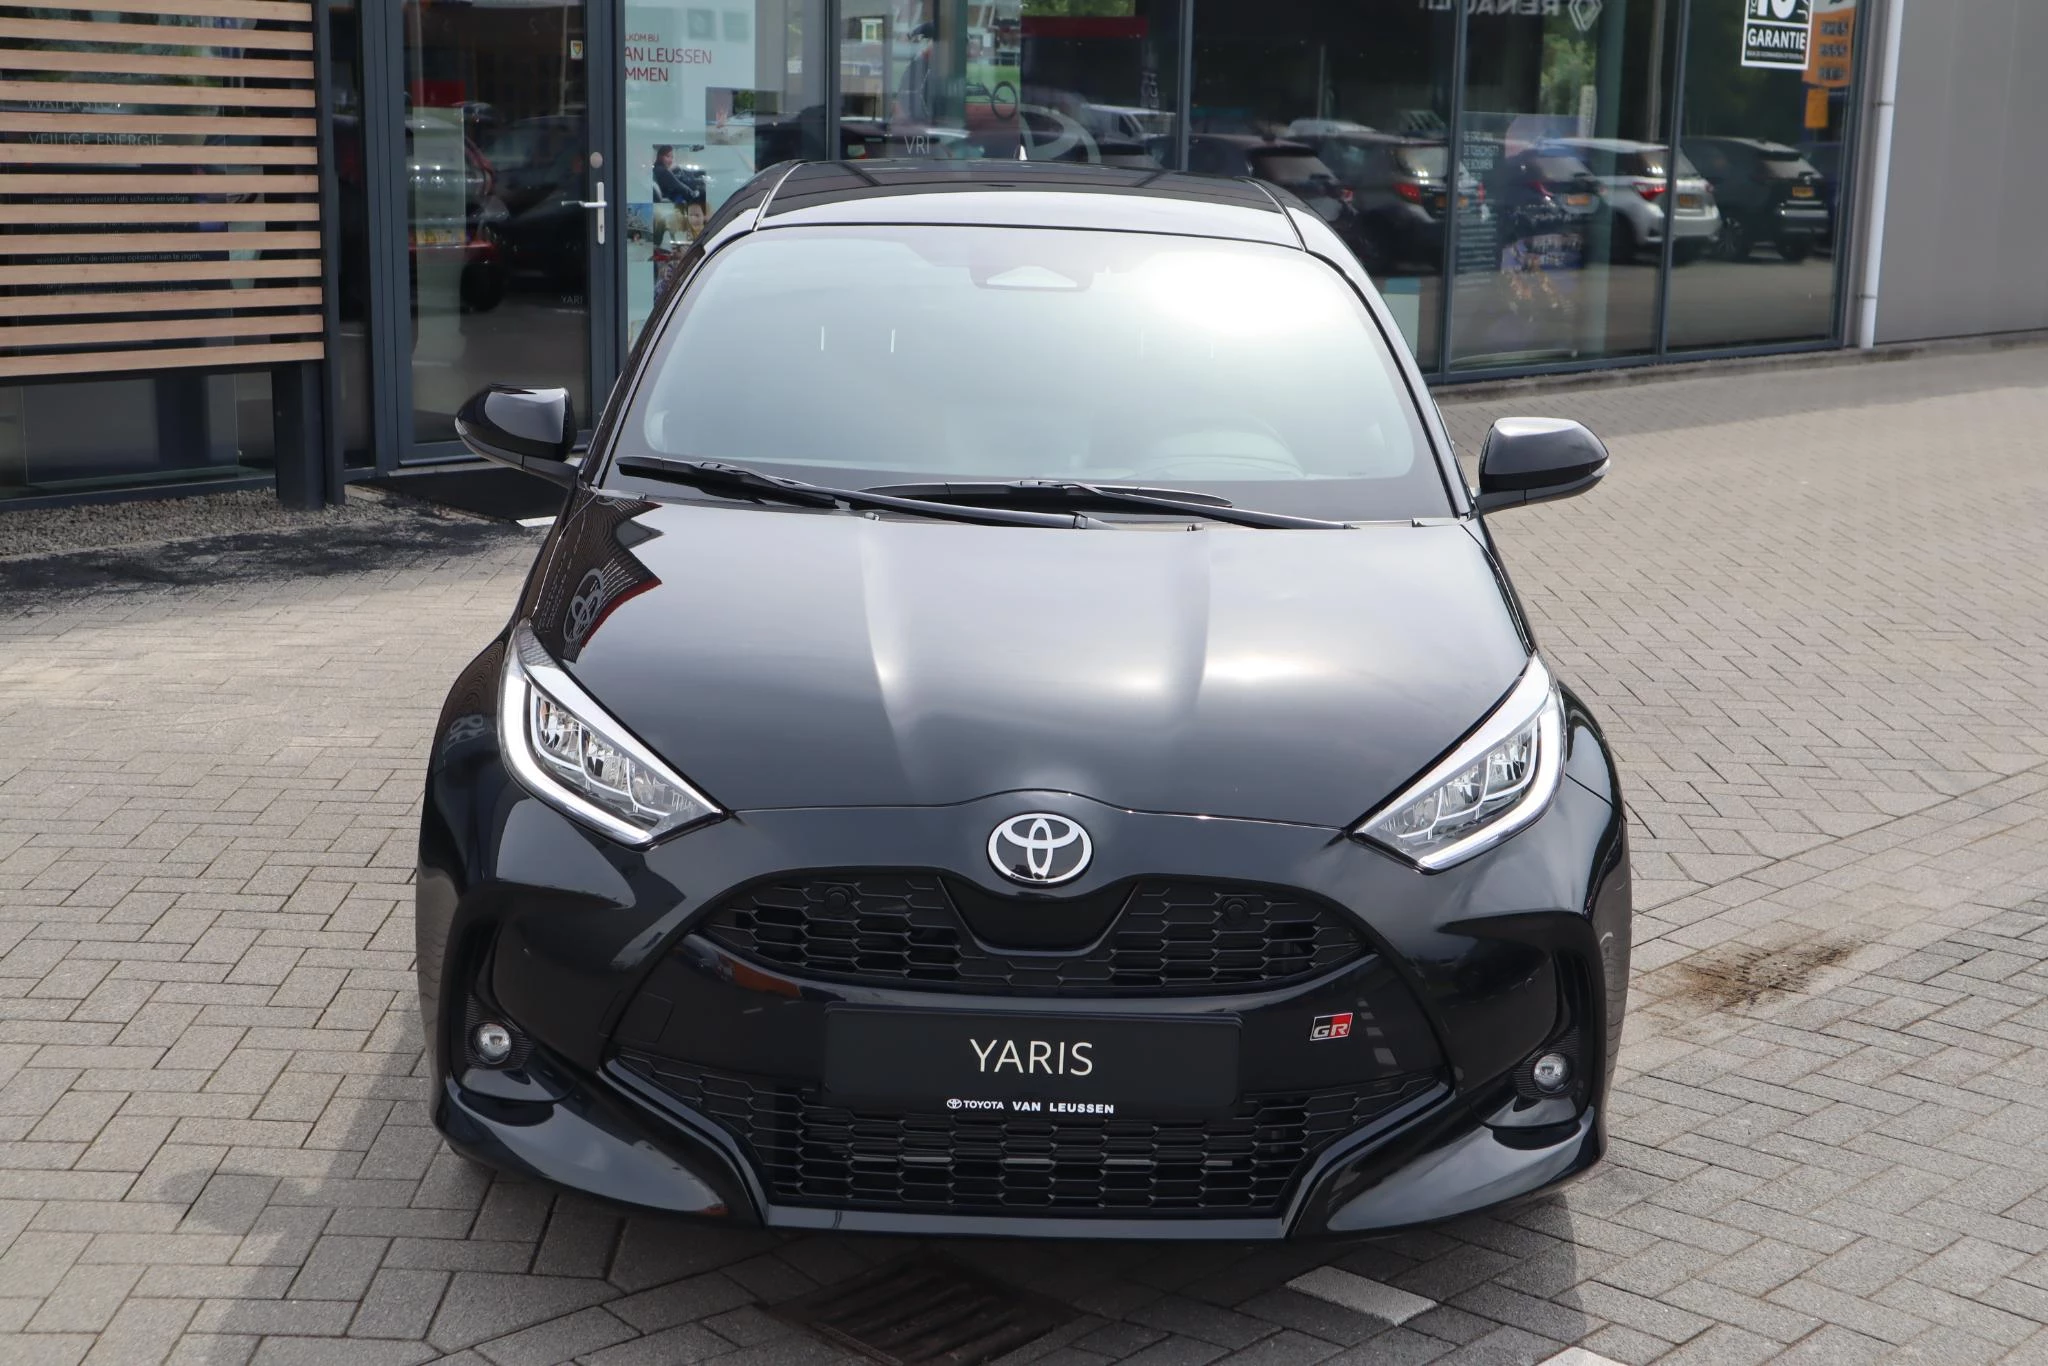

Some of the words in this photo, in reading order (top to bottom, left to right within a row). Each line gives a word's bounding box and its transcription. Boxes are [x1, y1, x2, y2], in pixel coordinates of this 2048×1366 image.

[1747, 27, 1806, 50] GARANTIE
[647, 47, 712, 64] LEUSSEN
[624, 67, 668, 82] MMEN
[97, 134, 164, 146] ENERGIE
[1313, 1023, 1349, 1038] GR
[969, 1038, 1094, 1076] YARIS
[963, 1099, 1005, 1110] TOYOTA
[1012, 1101, 1041, 1112] VAN
[1049, 1102, 1114, 1114] LEUSSEN
